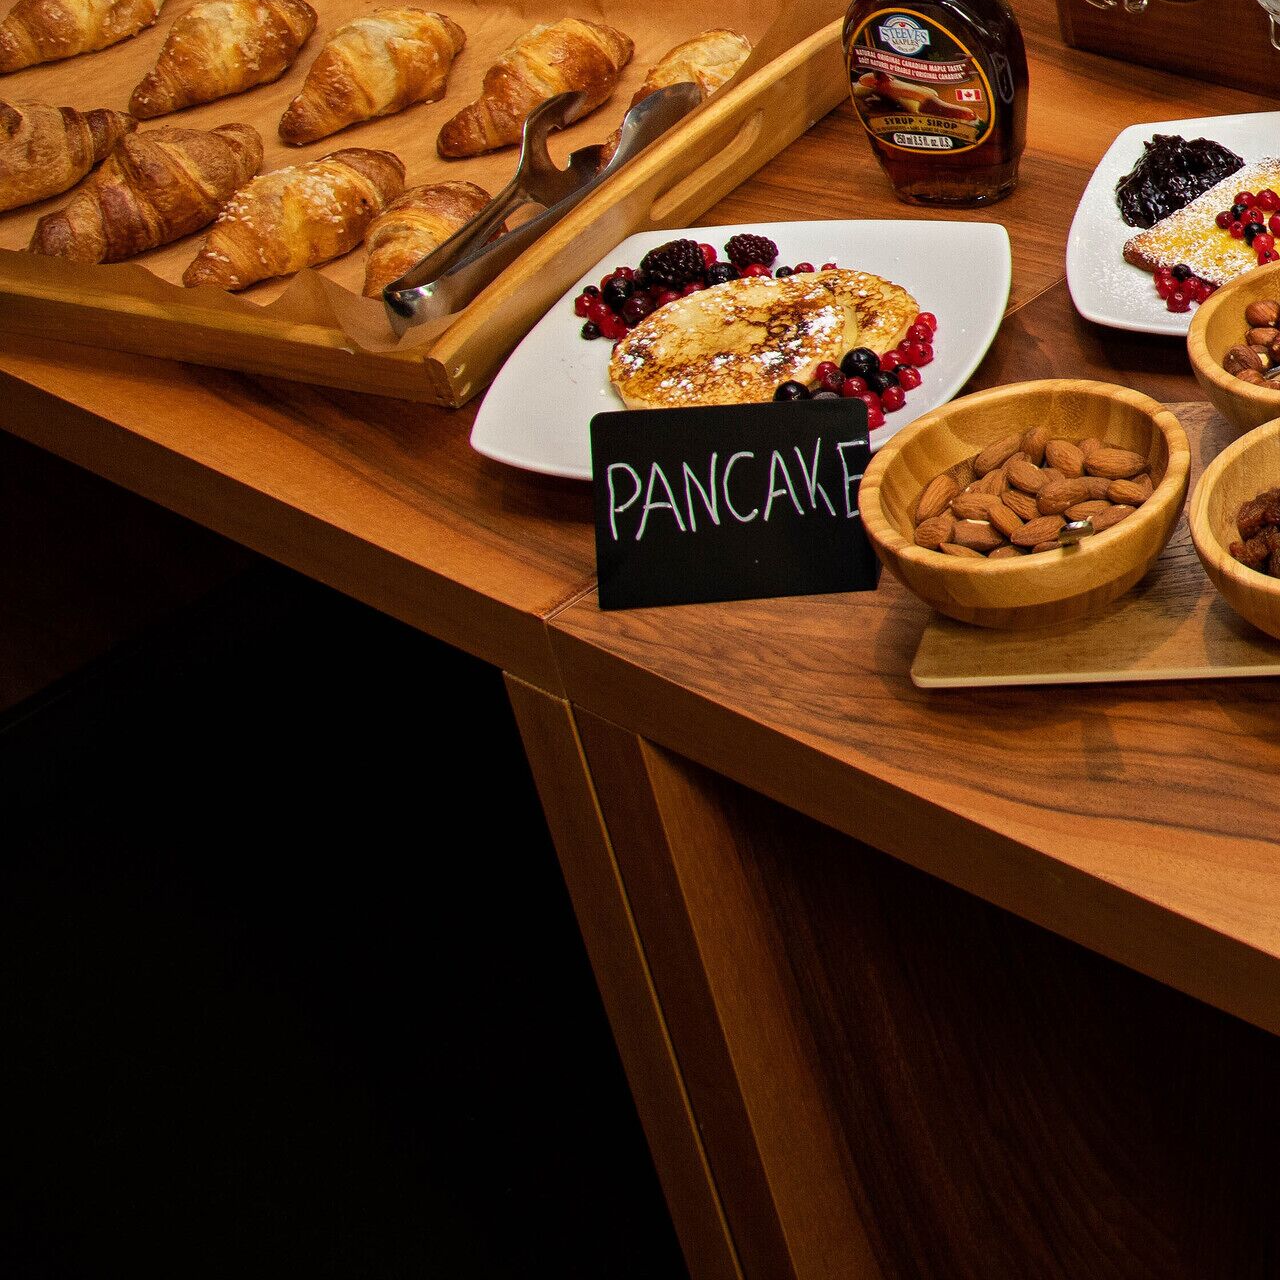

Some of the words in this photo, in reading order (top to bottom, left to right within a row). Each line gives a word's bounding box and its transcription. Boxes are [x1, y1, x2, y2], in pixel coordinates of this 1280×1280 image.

[881, 28, 927, 44] STEEVES
[884, 117, 914, 125] SYRUP
[926, 119, 958, 129] SIROP
[606, 437, 866, 541] PANCAKE
